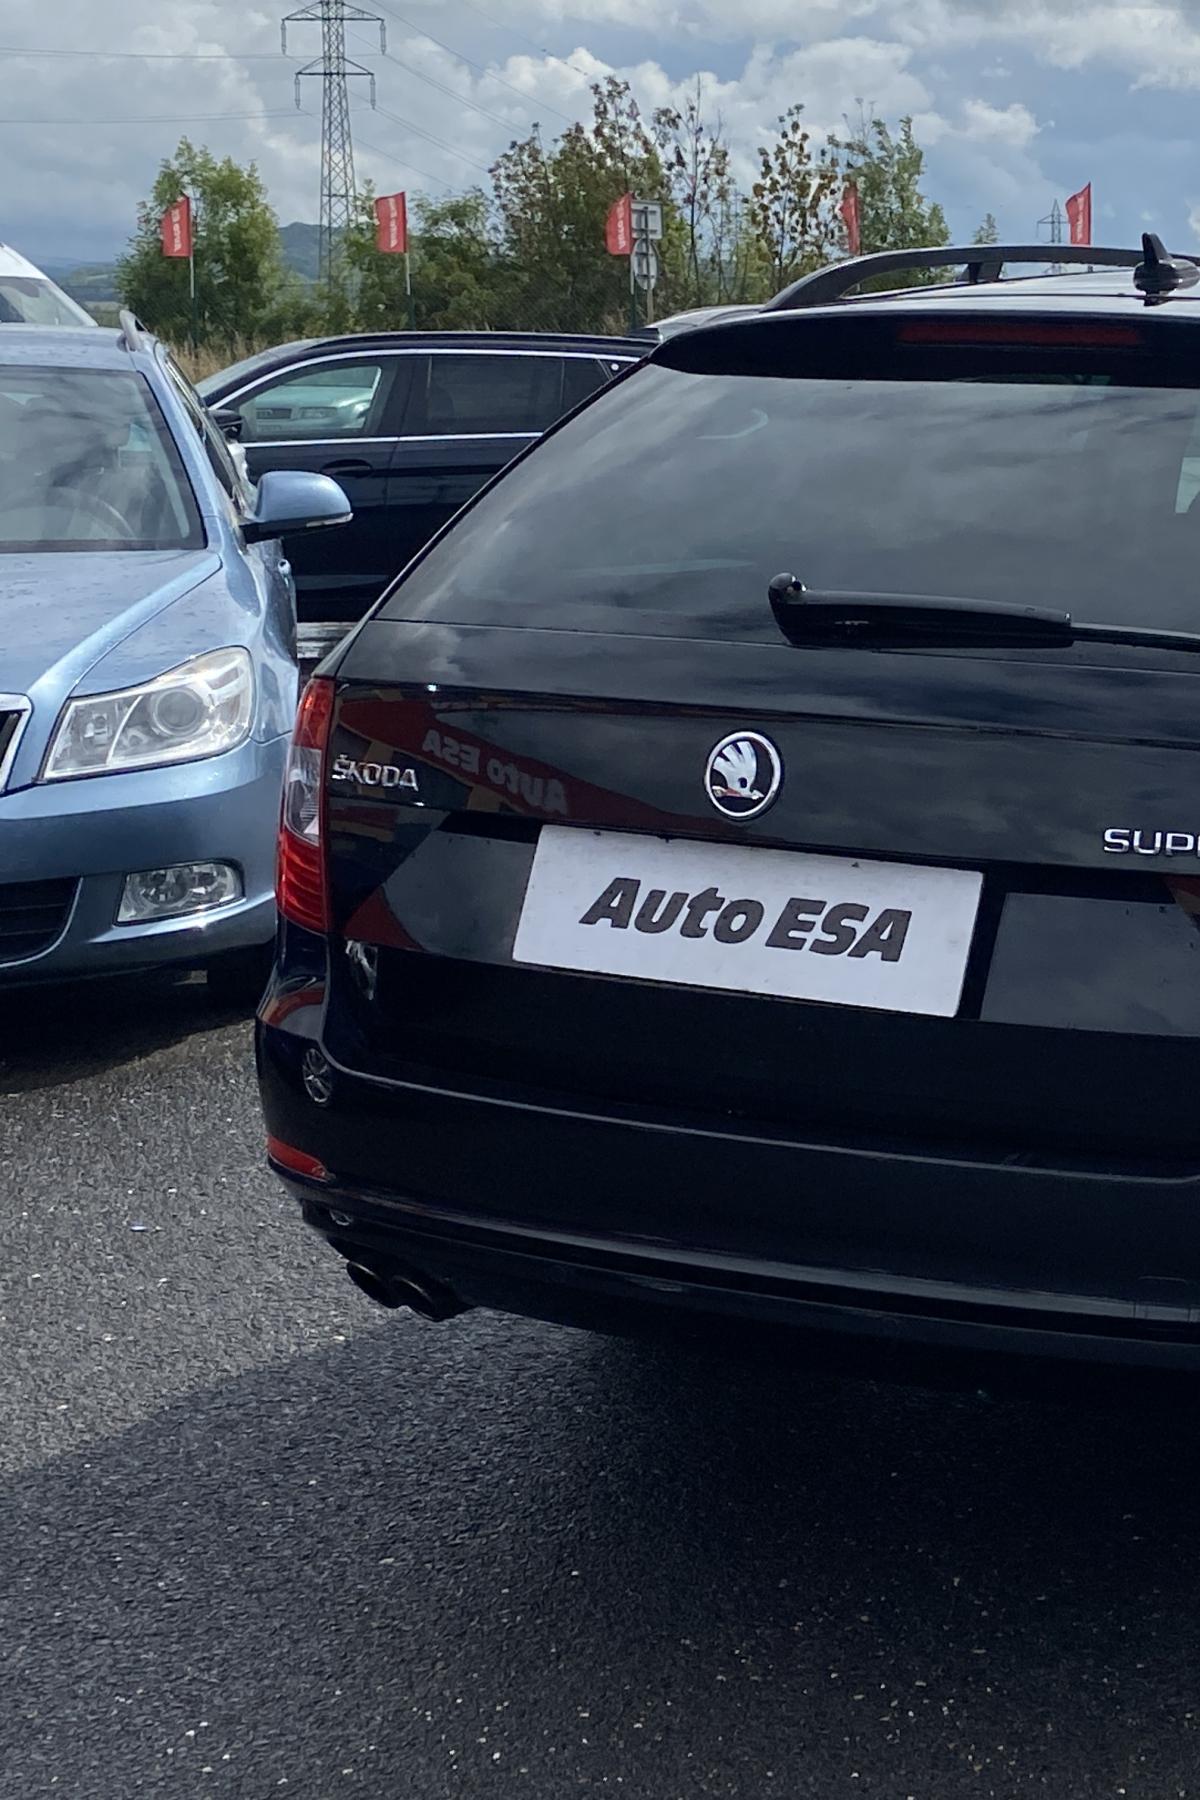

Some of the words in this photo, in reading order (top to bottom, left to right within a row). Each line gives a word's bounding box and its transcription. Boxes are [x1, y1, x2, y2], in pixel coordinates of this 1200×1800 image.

[332, 753, 419, 791] ŠKODA
[579, 876, 766, 945] Auto
[765, 896, 912, 963] ESA
